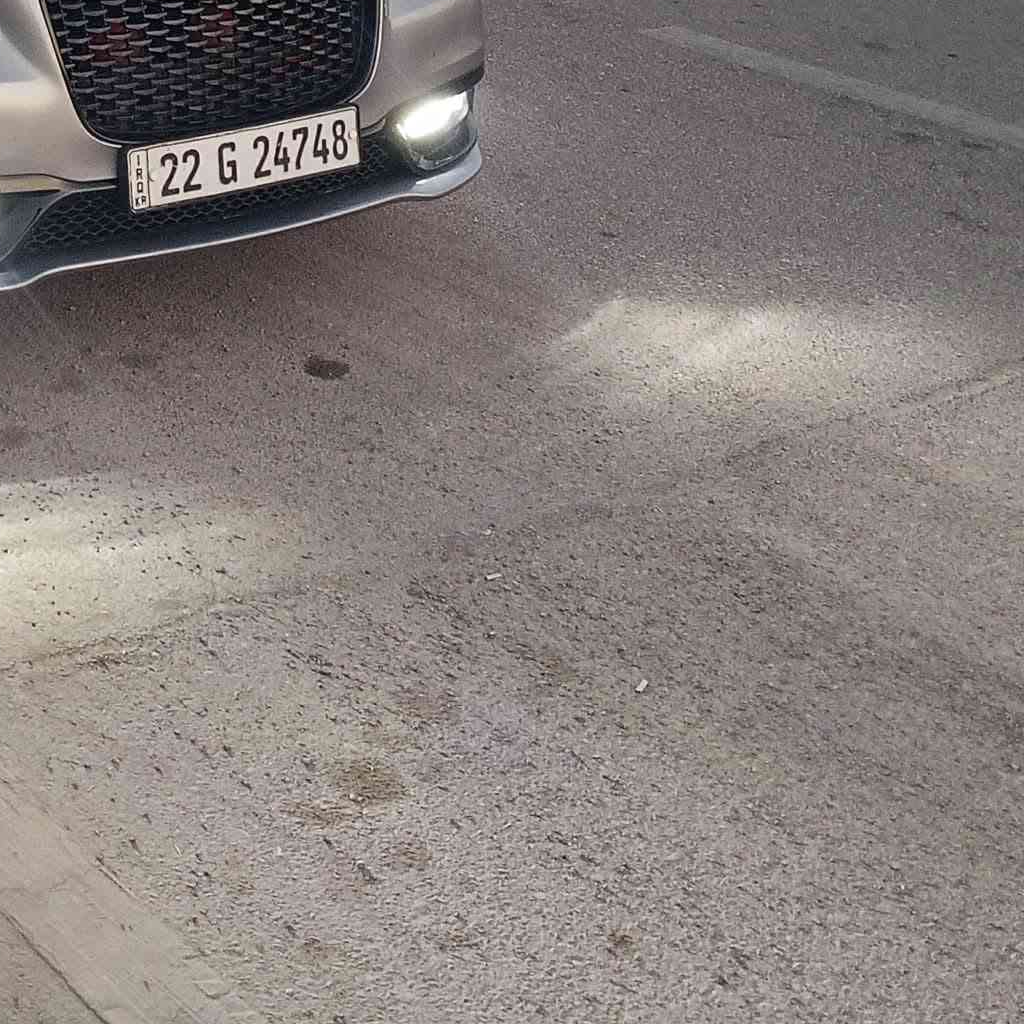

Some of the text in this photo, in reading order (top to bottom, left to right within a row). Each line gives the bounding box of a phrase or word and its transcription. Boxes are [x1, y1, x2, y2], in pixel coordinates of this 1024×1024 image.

[161, 119, 349, 197] 22 G 24748
